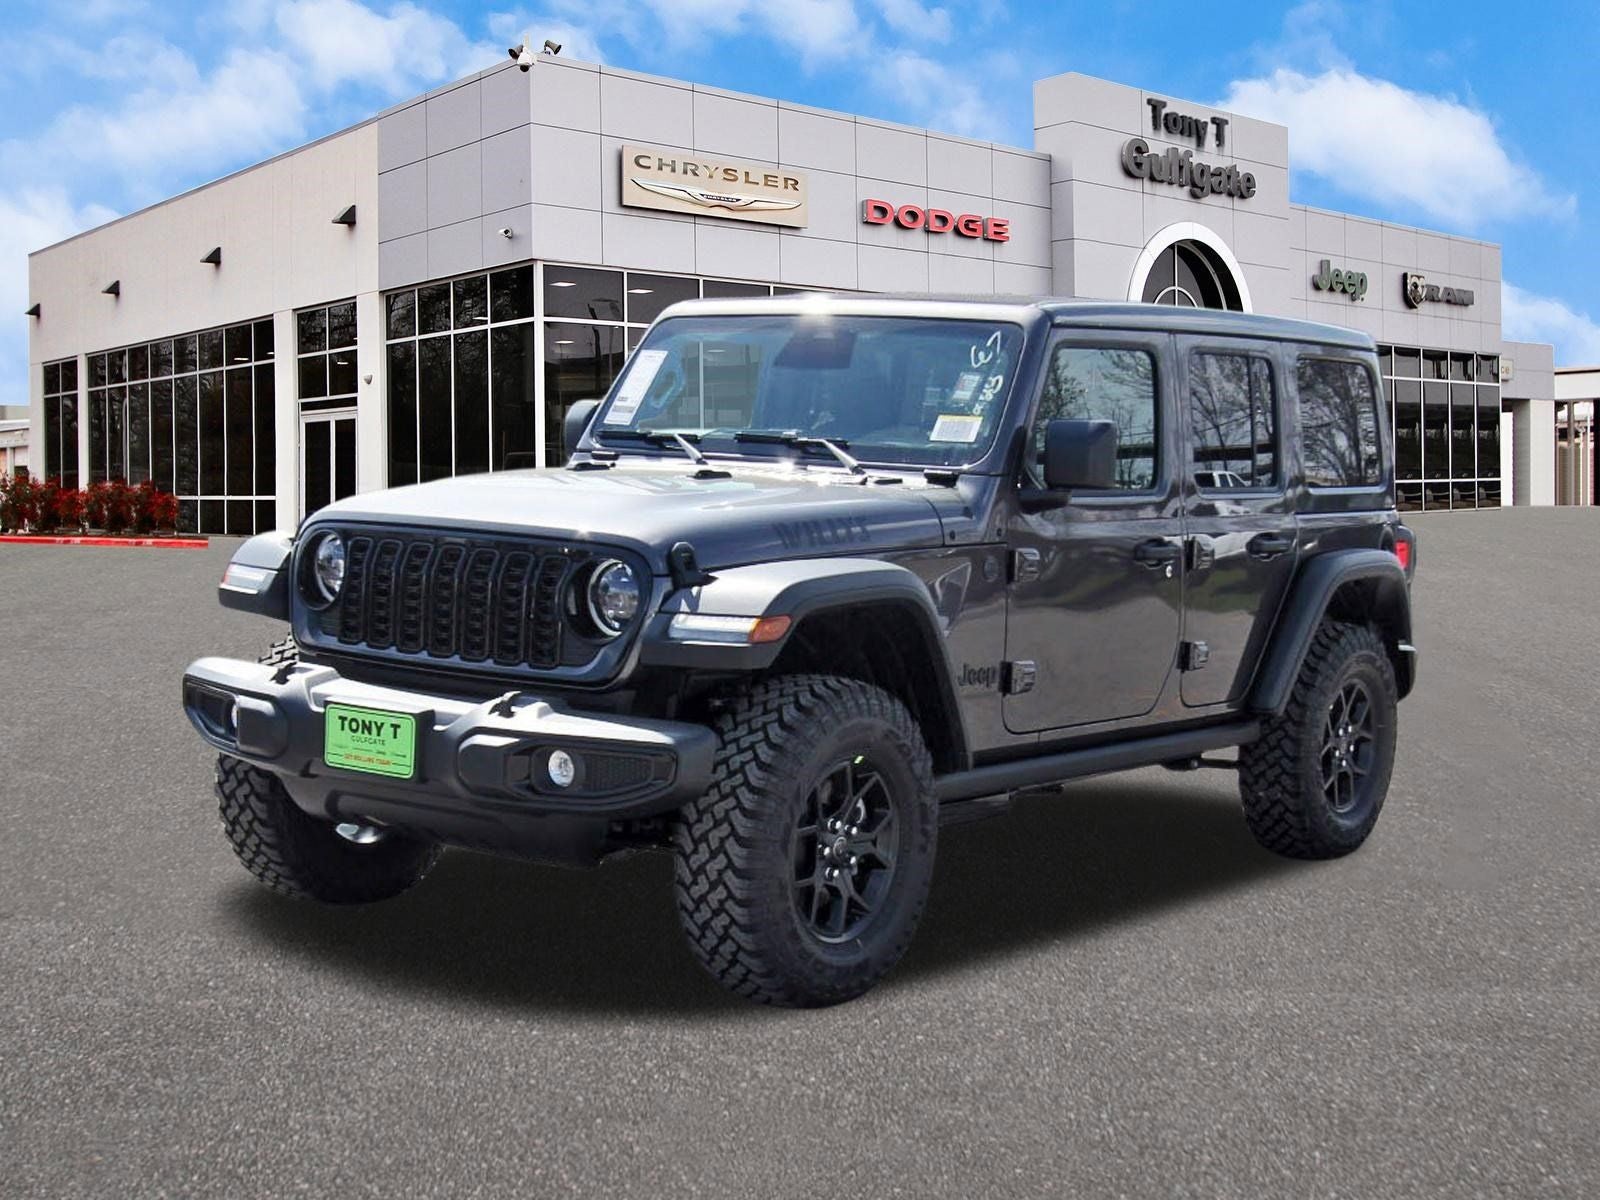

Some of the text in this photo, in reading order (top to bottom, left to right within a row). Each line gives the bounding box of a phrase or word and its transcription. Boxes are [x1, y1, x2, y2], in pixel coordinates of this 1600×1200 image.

[1147, 98, 1229, 147] Tony T
[633, 154, 801, 192] CHRYSLER
[1121, 137, 1256, 199] Gulfgate
[863, 198, 1010, 242] DODGE
[1313, 259, 1368, 301] Jeep
[1425, 283, 1475, 306] RAM
[958, 664, 996, 688] Jeep
[338, 715, 401, 739] TONY T
